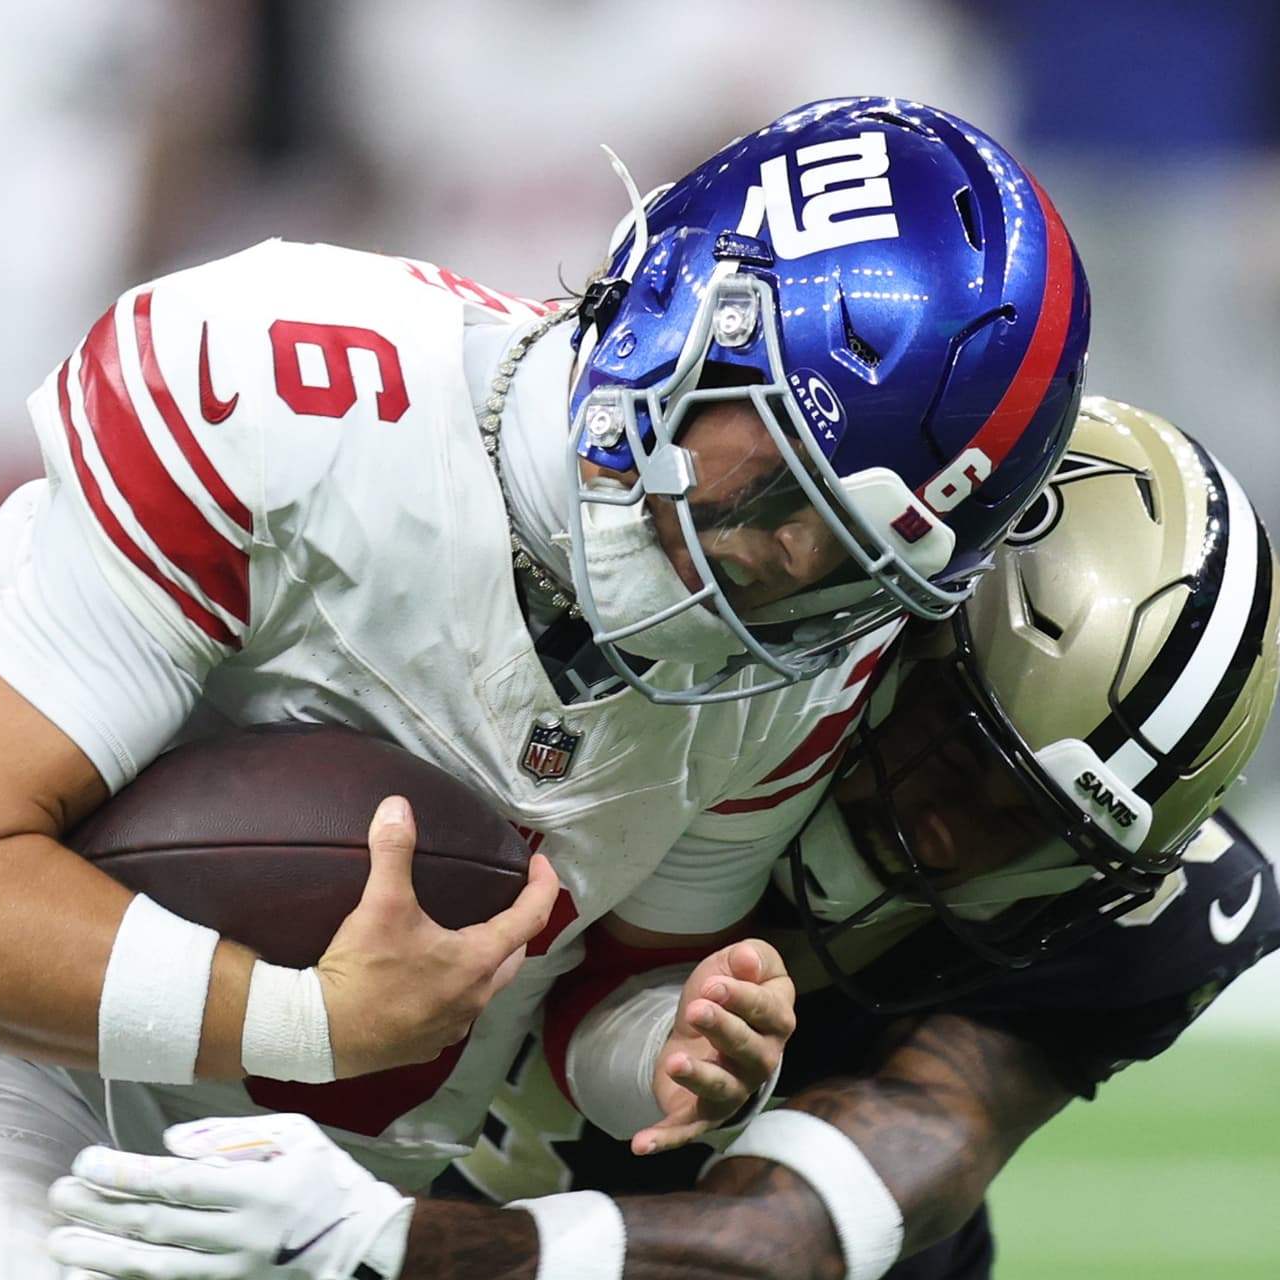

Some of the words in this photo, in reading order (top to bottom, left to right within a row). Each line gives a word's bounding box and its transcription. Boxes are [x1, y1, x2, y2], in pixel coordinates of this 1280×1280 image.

[268, 319, 410, 423] 6
[790, 374, 837, 440] OAKLEY
[923, 447, 992, 512] 6
[523, 743, 570, 776] NFL
[1074, 771, 1138, 828] SAINTS
